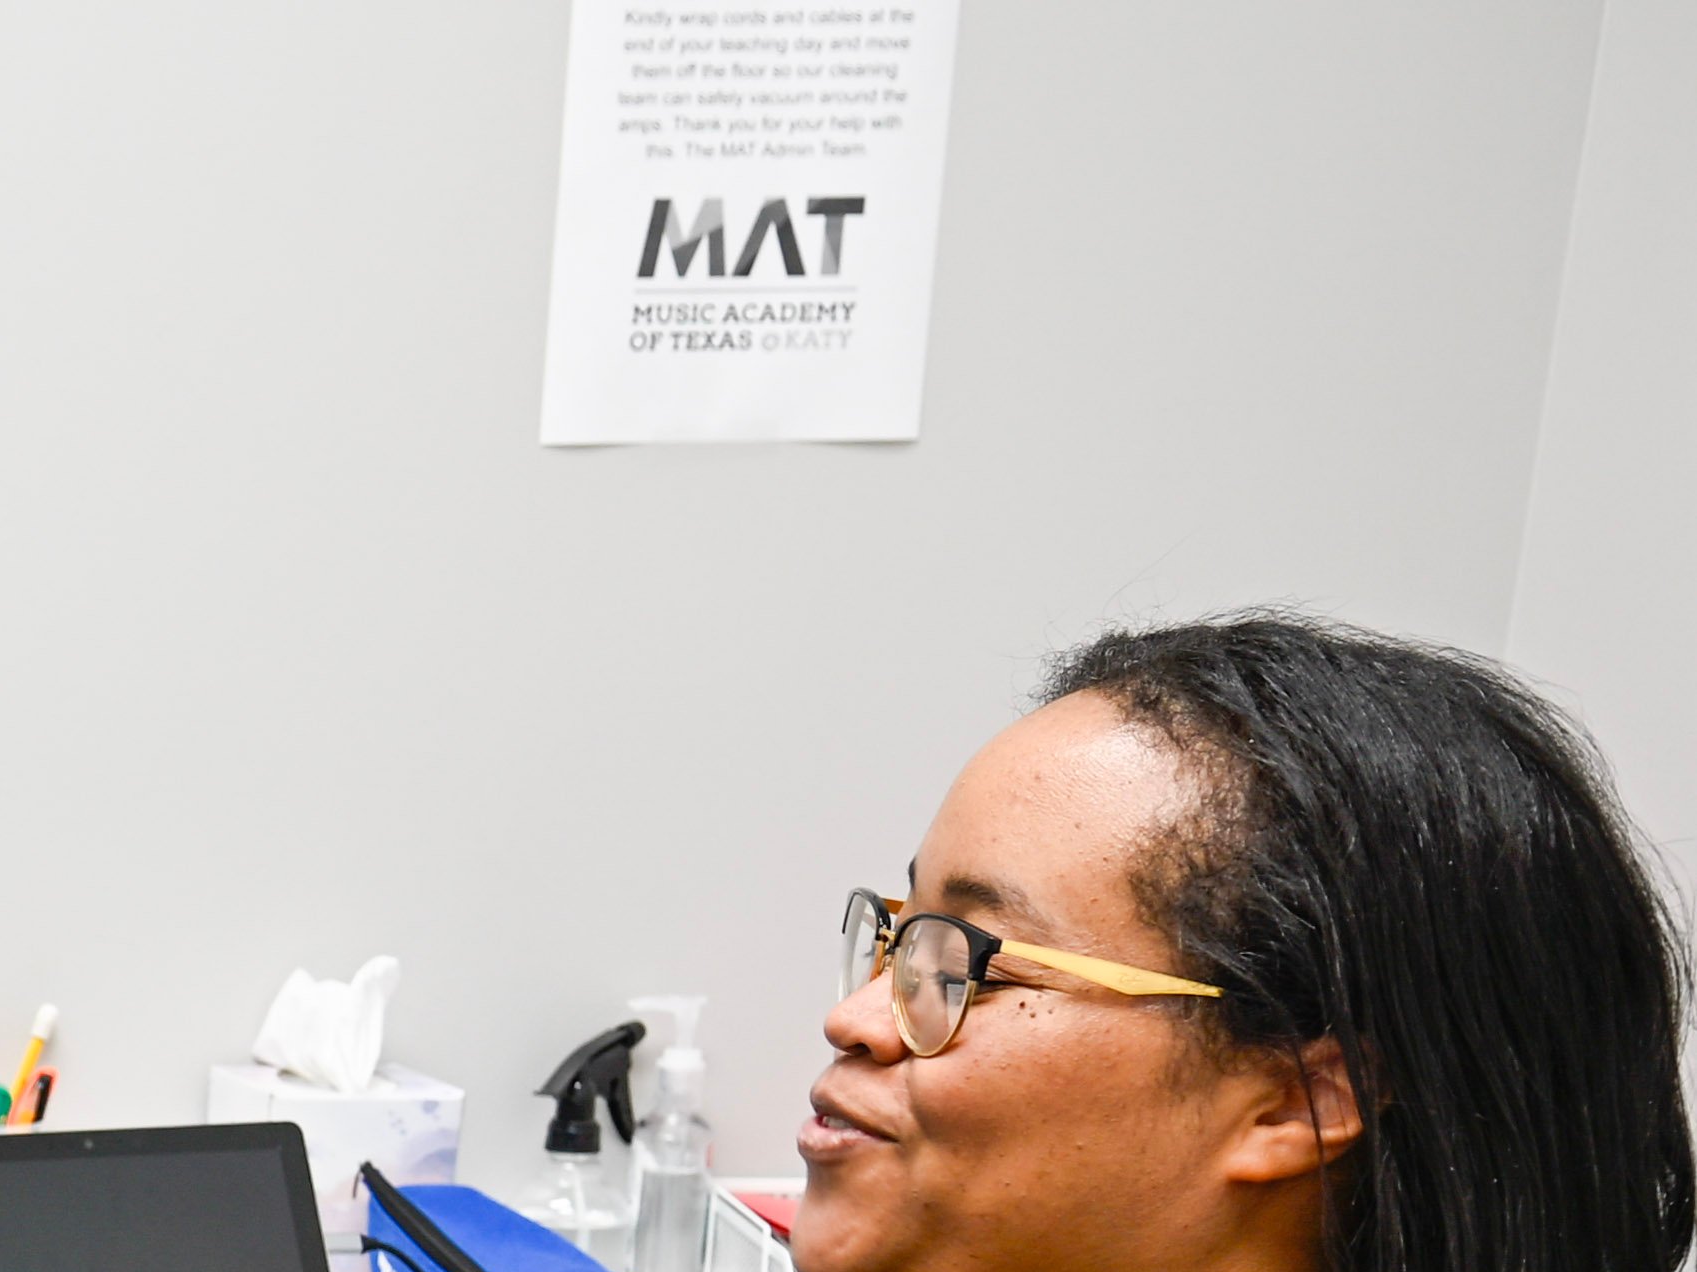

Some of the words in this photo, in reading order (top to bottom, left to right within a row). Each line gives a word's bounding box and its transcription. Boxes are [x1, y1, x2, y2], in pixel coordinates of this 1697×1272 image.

[637, 197, 866, 278] MAT
[632, 303, 717, 325] MUSIC
[721, 302, 855, 324] ACADEMY
[630, 331, 663, 352] OF
[670, 330, 752, 351] TEXAS
